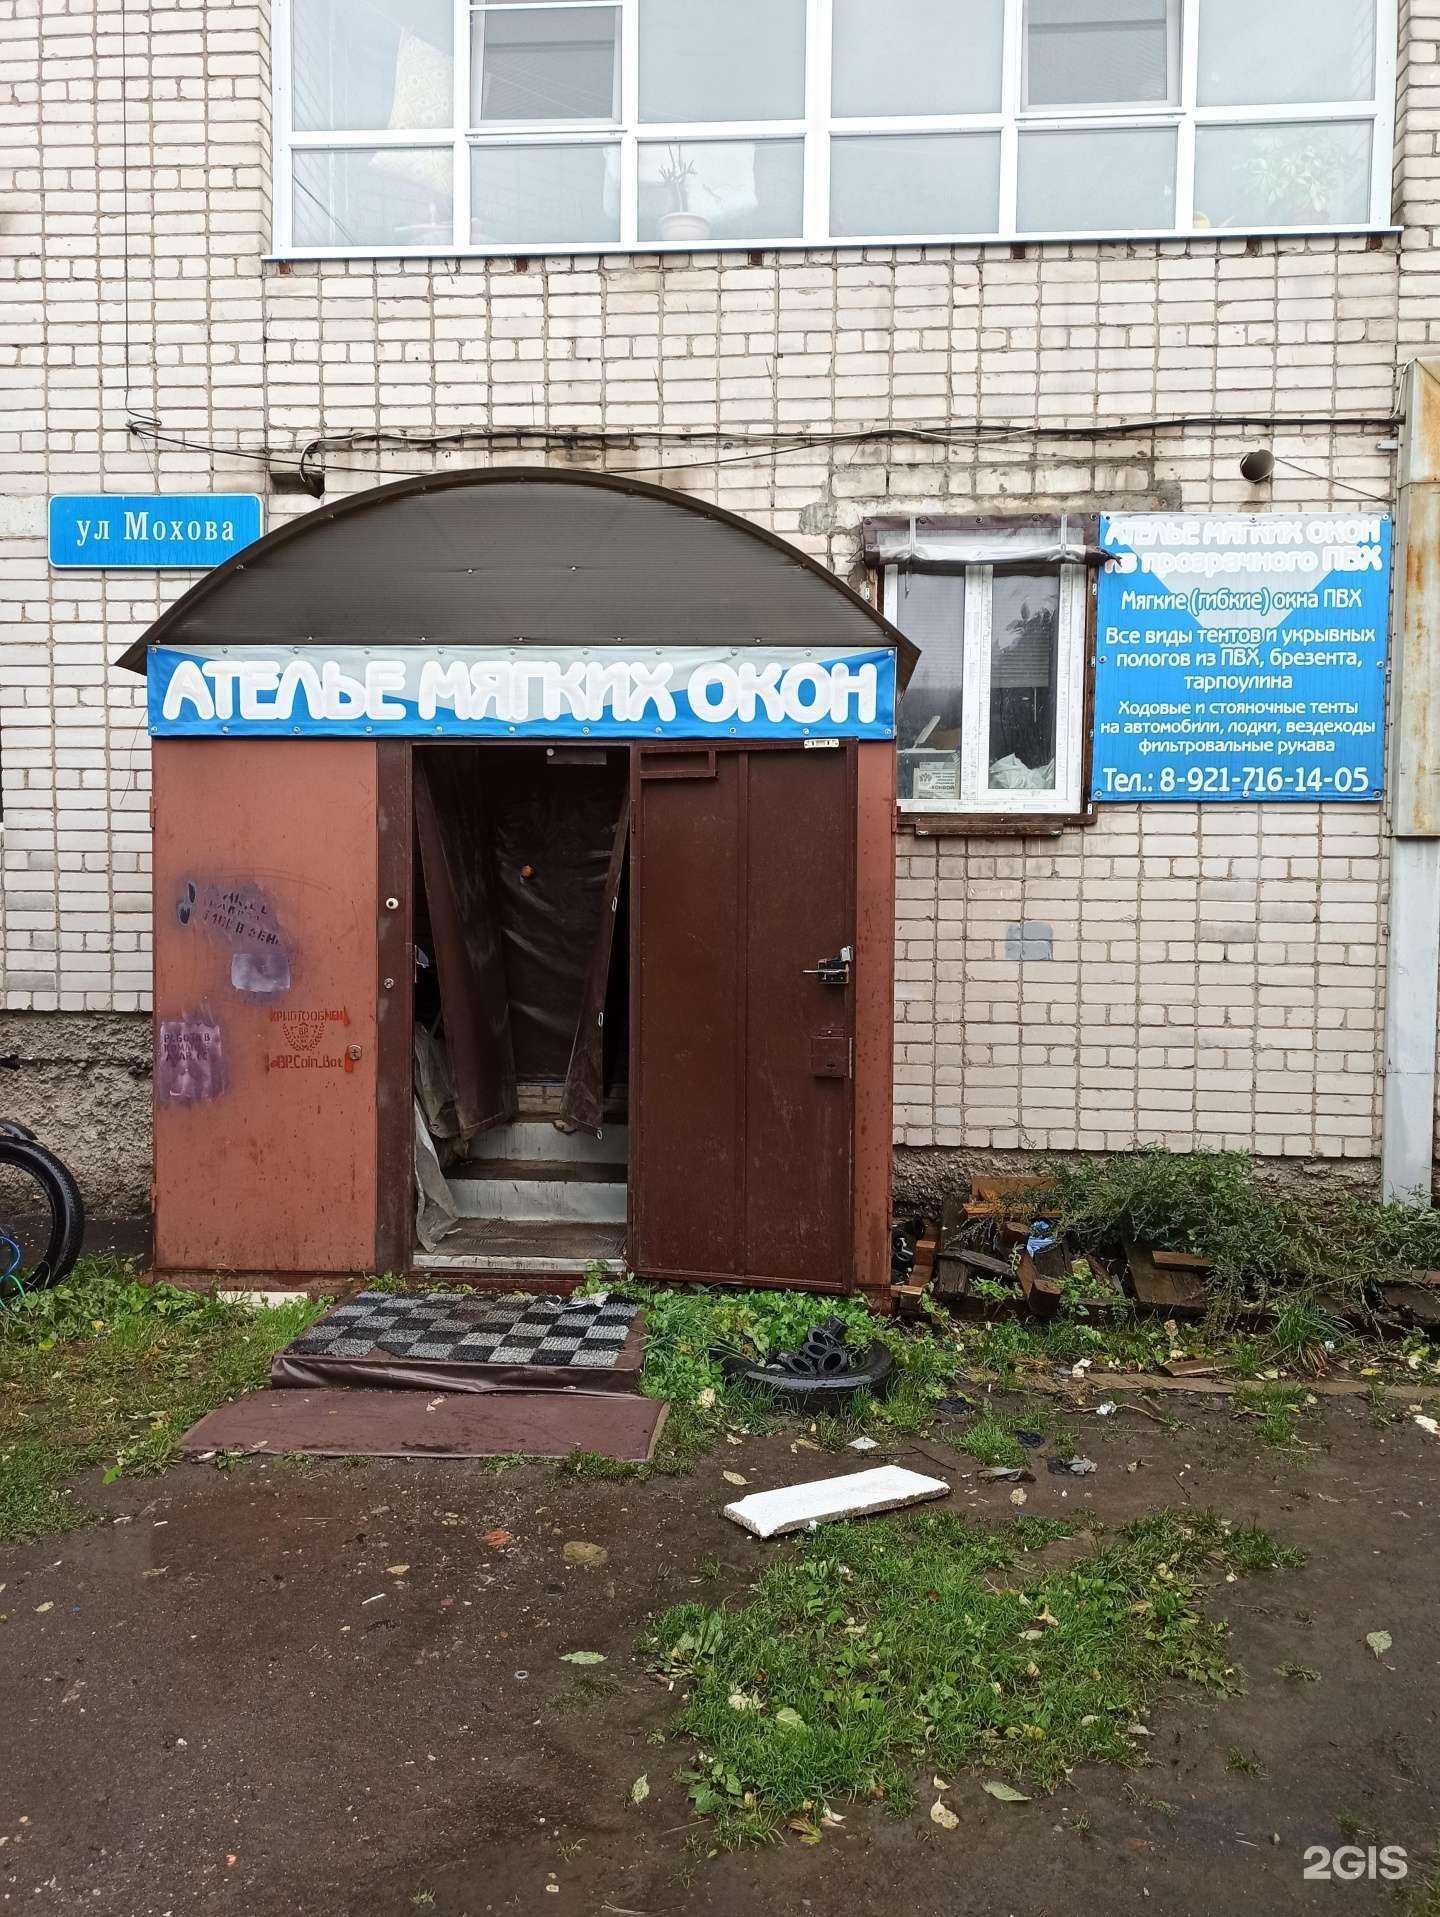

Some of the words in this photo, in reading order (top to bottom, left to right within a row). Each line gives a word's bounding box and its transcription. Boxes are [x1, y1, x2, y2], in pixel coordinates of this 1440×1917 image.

[76, 519, 111, 547] ул
[124, 511, 234, 541] Мохова
[1306, 518, 1382, 544] ОКОН
[1141, 550, 1318, 578] прозрачного
[1322, 545, 1383, 573] ПВХ
[1121, 590, 1187, 610] Мягкие
[1188, 587, 1271, 616] (гибкие)
[1274, 592, 1318, 610] окна
[1323, 588, 1363, 608] ПВХ
[1106, 627, 1140, 645] Все
[1145, 628, 1192, 647] виды
[1199, 628, 1262, 645] тентов
[1266, 628, 1277, 643] и
[1282, 627, 1376, 647] укрывных
[1116, 652, 1190, 668] пологов
[1195, 652, 1216, 667] из
[1221, 649, 1264, 669] ПВХ,
[1269, 648, 1363, 669] брезента,
[162, 660, 407, 722] АТЕЛЬЕ
[418, 661, 677, 721] МЯГКИХ
[688, 663, 877, 723] ОКОН
[1184, 674, 1293, 693] тарпоулина
[1118, 701, 1191, 717] Ходовые
[1195, 702, 1205, 714] и
[1209, 701, 1305, 715] стояночные
[1310, 700, 1359, 714] тенты
[1100, 721, 1120, 734] на
[1123, 718, 1225, 736] автомобили,
[1228, 719, 1281, 736] лодки,
[1286, 719, 1376, 736] вездеходы
[1138, 738, 1274, 756] фильтровальные
[1277, 739, 1335, 755] рукава
[1103, 767, 1153, 793] Тел.:
[1159, 767, 1369, 793] 8-921-716-14-05
